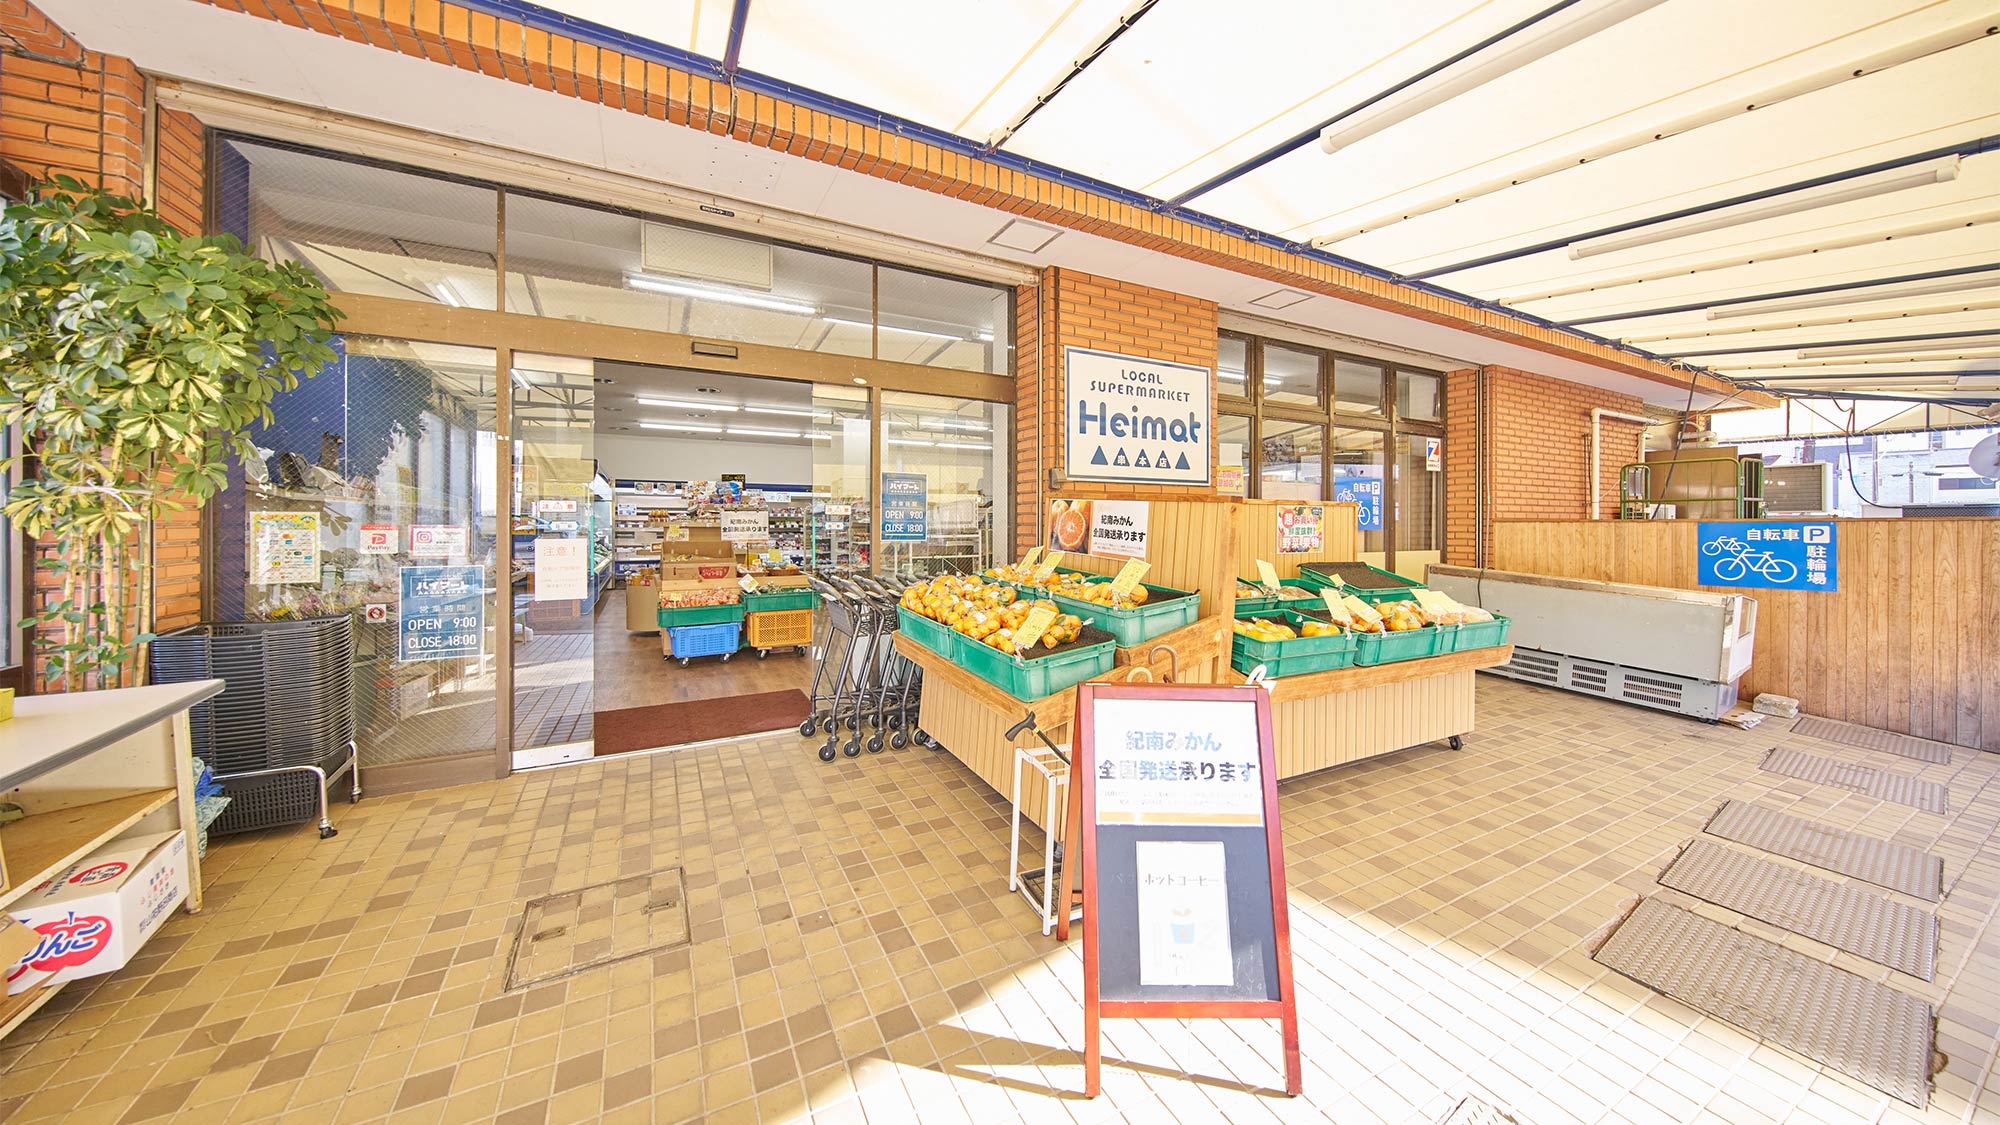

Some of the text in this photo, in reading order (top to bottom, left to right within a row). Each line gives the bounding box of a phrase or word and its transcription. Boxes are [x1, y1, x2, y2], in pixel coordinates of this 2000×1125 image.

[1121, 369, 1163, 385] LOCAL
[1090, 380, 1190, 402] SUPERMARKET
[1079, 400, 1201, 443] Heimat
[885, 510, 924, 519] OPEN 9:00
[1101, 514, 1133, 526] 紀南みかん
[885, 524, 923, 533] CLOSE 18:00
[1093, 527, 1146, 542] 全国発送承ります
[1746, 528, 1825, 541] 自転車 P
[1806, 545, 1827, 585] 駐輪場
[408, 616, 477, 631] OPEN 9:00
[408, 634, 477, 649] CLOSE 18:00
[1126, 730, 1222, 752] 紀南みかん
[1099, 760, 1256, 782] 全国発送承ります
